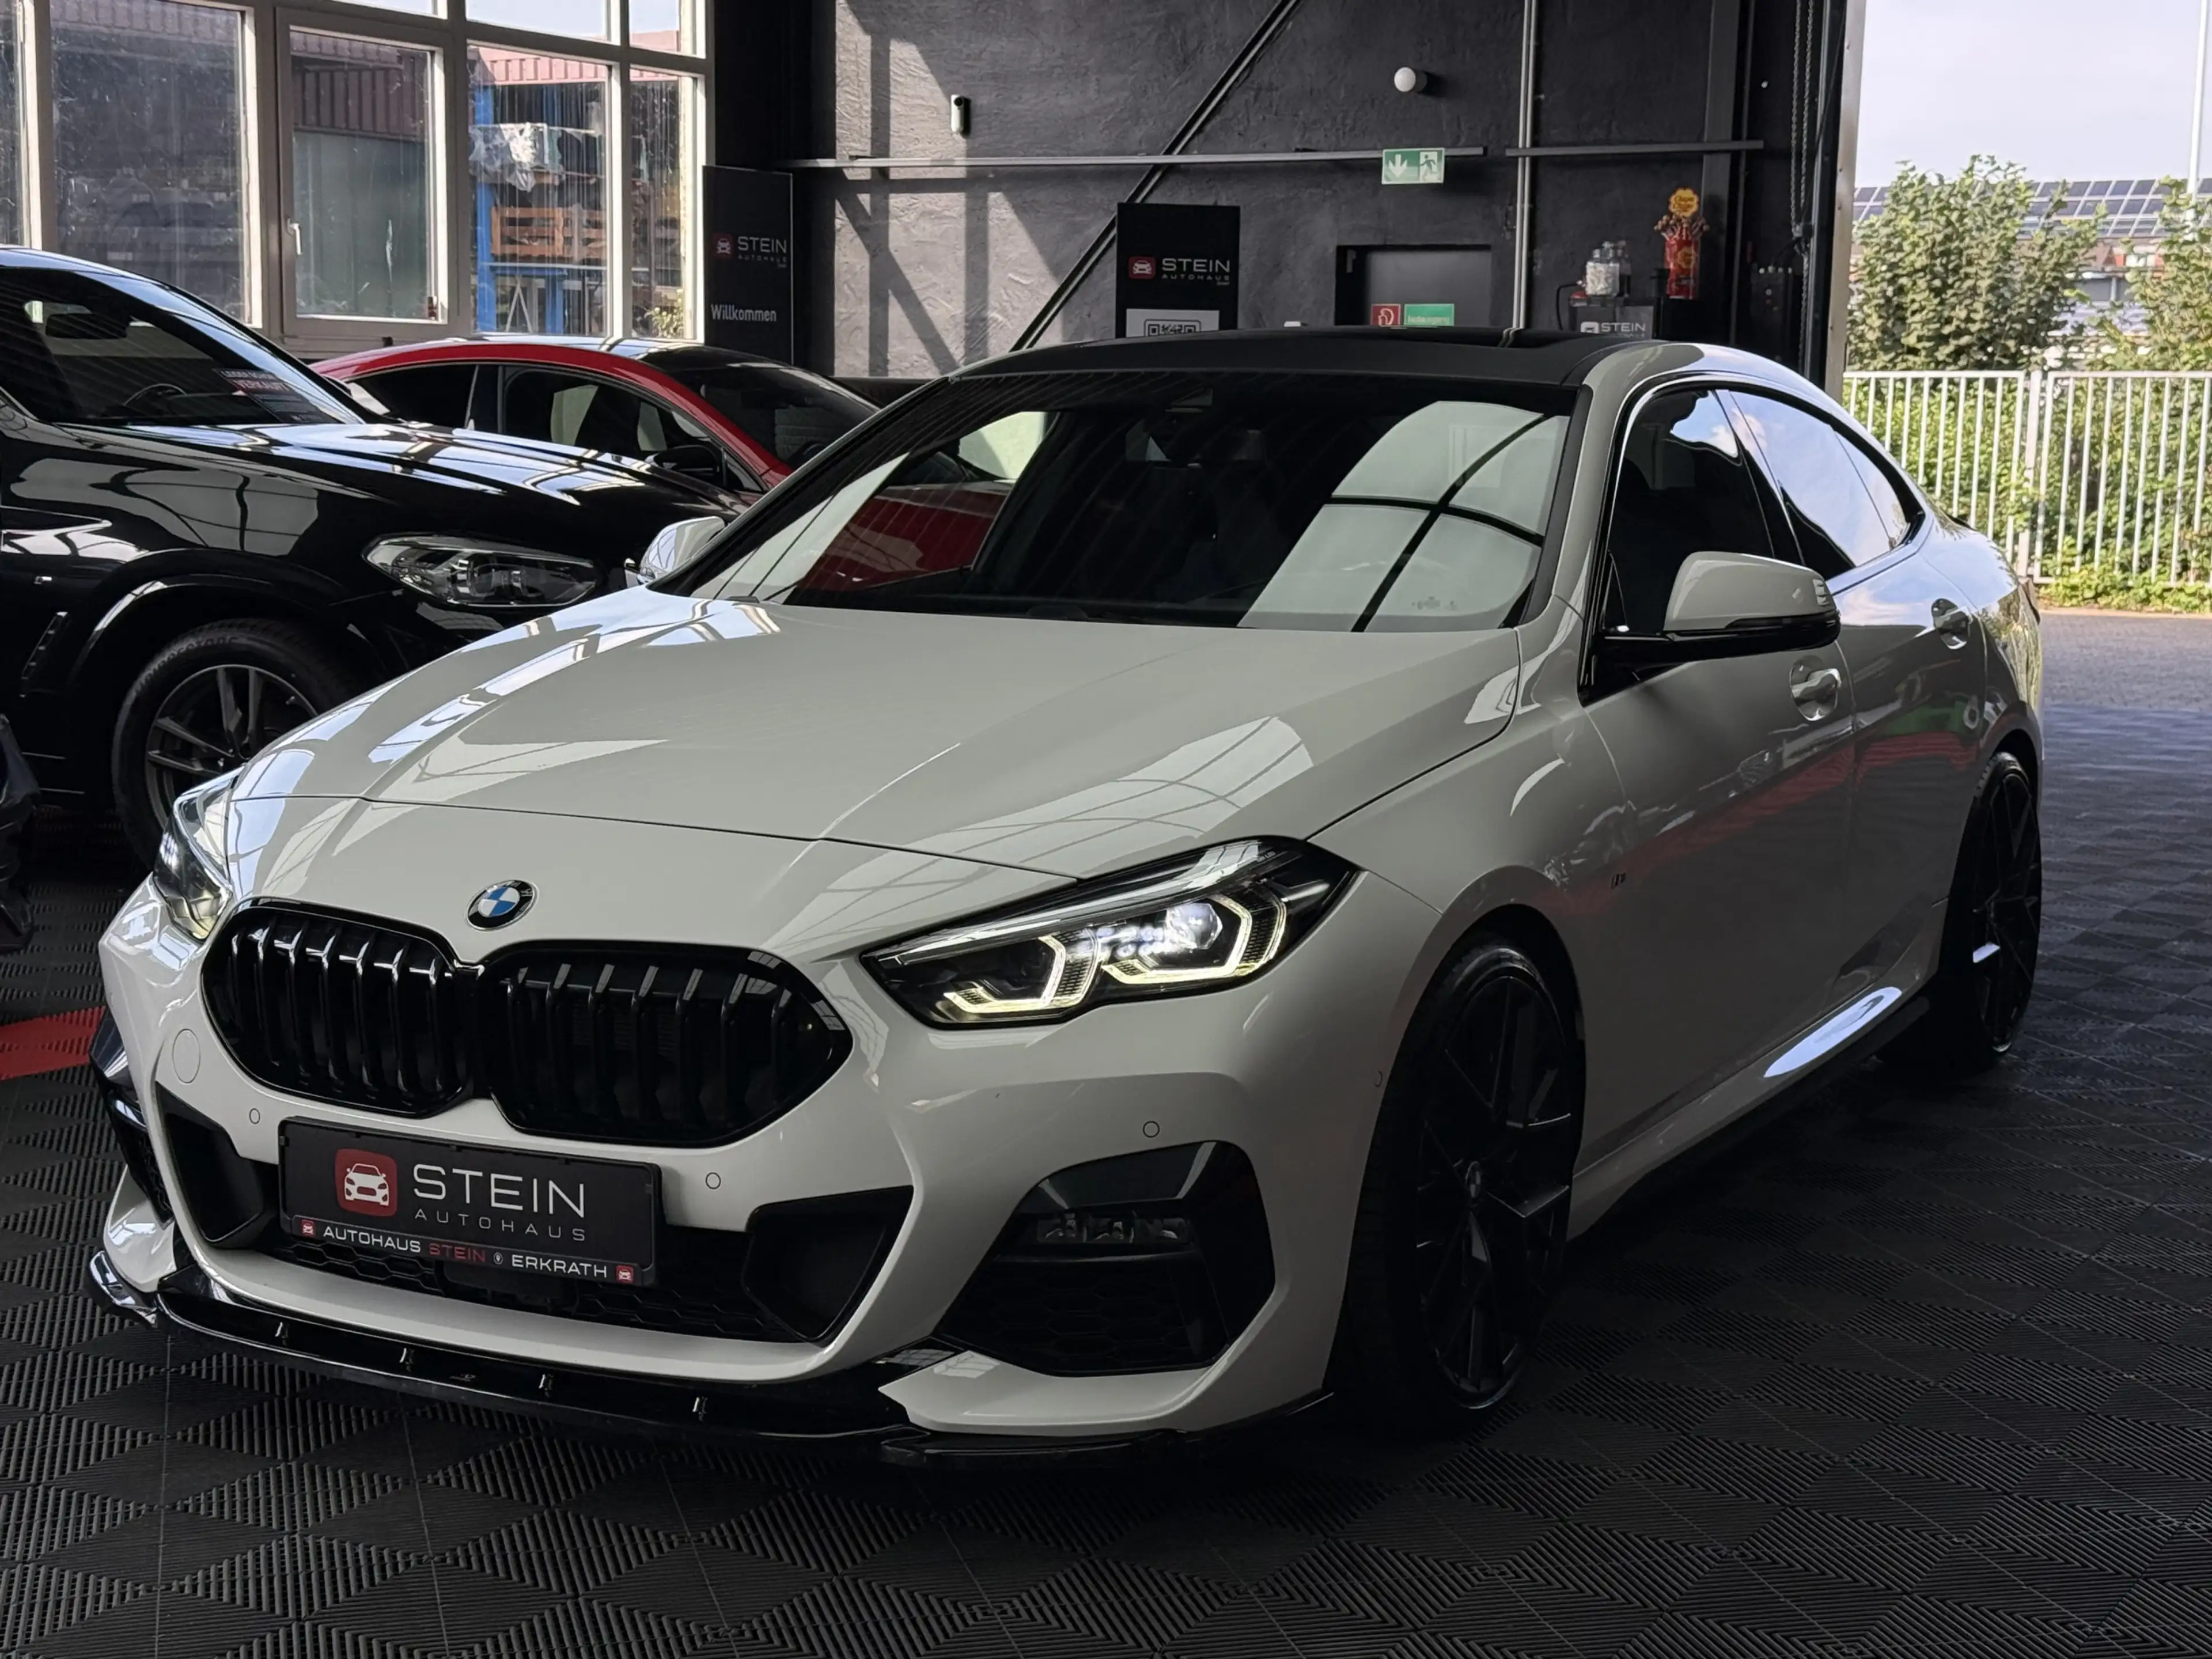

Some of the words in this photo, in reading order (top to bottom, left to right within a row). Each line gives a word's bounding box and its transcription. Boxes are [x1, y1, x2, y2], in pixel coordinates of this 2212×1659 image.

[737, 236, 787, 253] STEIN
[1161, 258, 1230, 273] STEIN
[710, 304, 777, 323] Willkommen
[1601, 323, 1646, 333] STEIN
[413, 1163, 585, 1218] STEIN
[414, 1208, 585, 1241] AUTOHAUS
[323, 1225, 421, 1253] AUTOHAUS
[429, 1243, 486, 1264] STEIN
[512, 1253, 607, 1278] ERKRATH
